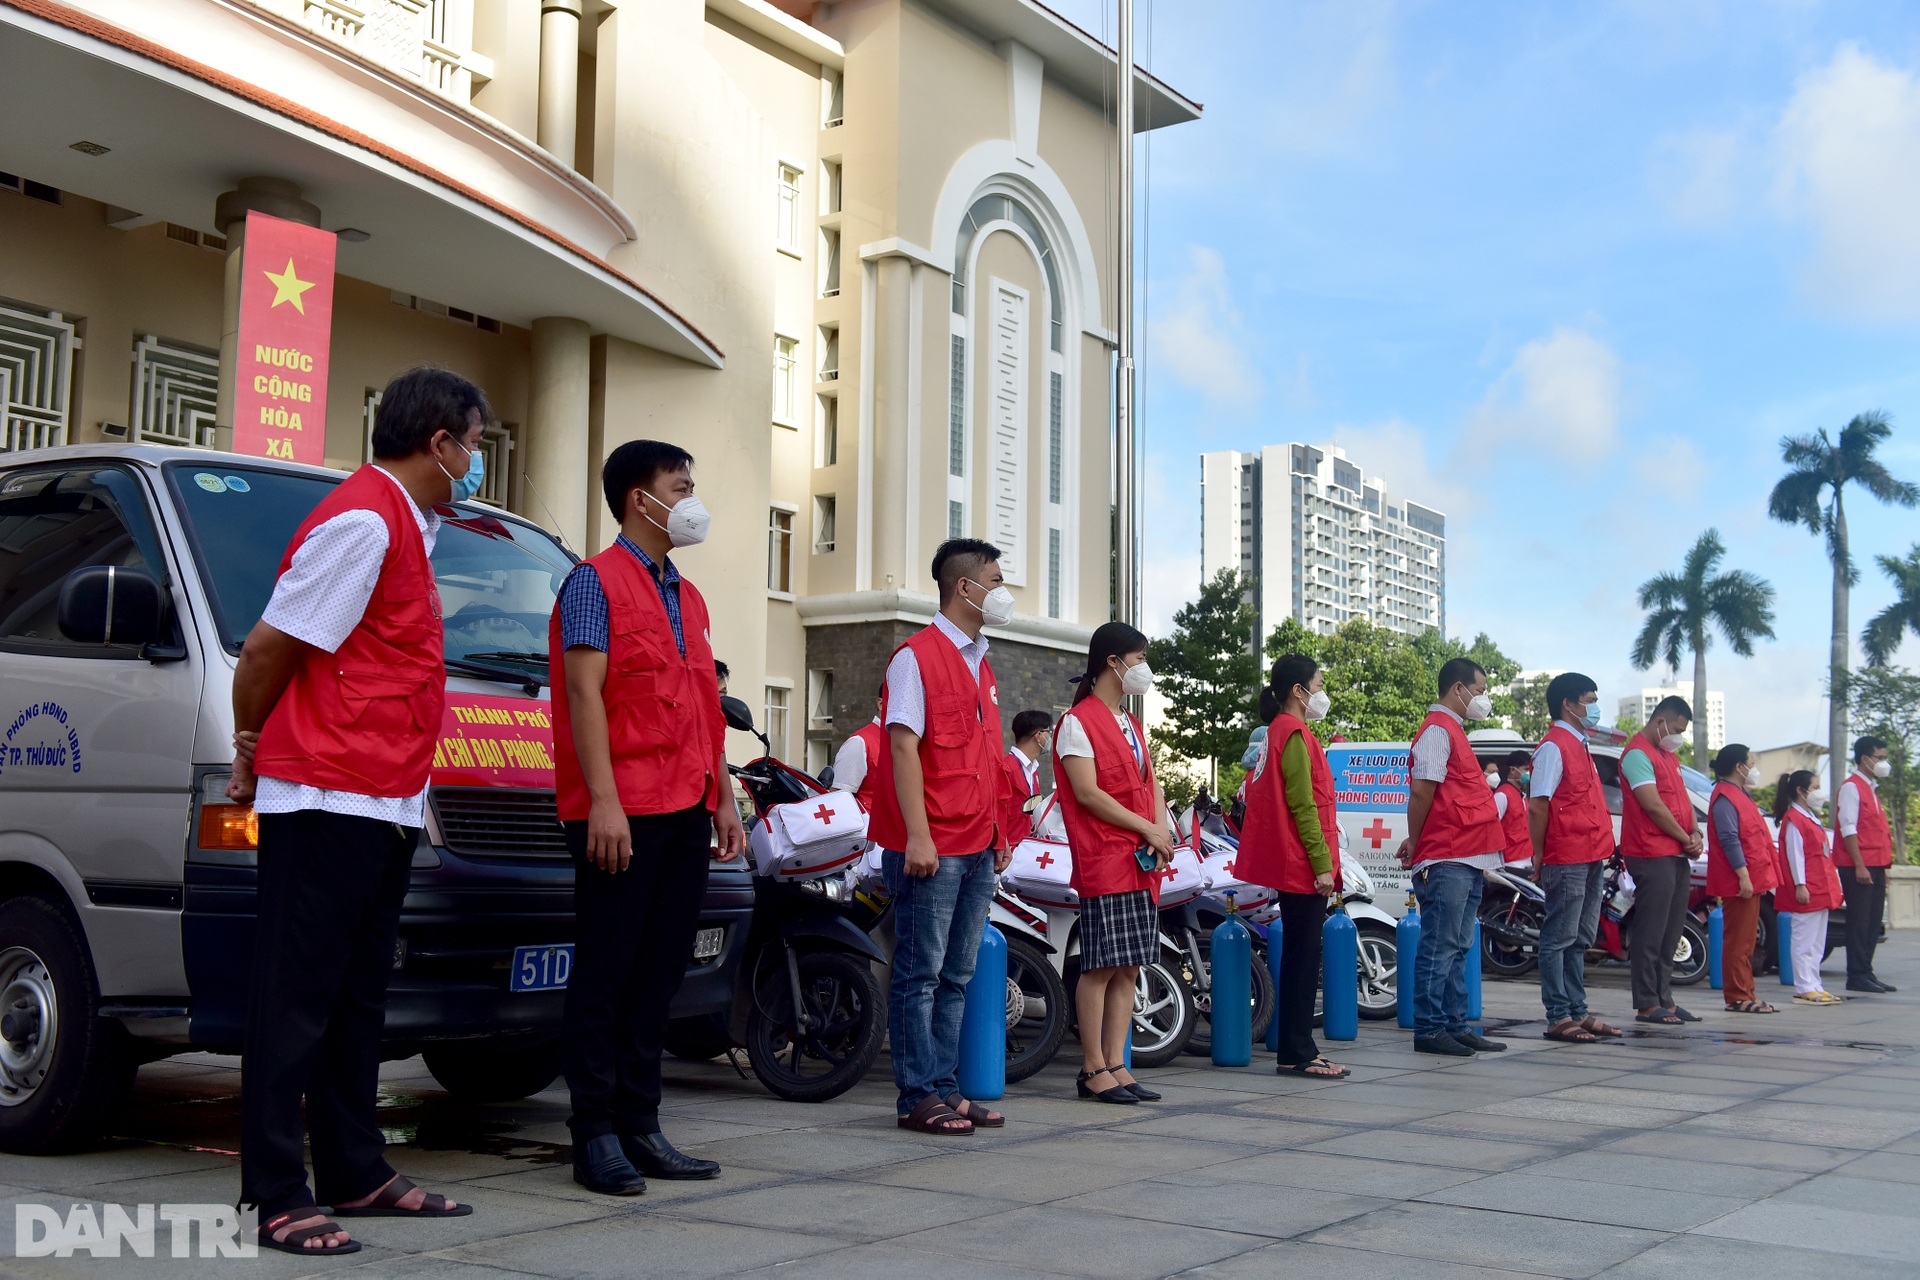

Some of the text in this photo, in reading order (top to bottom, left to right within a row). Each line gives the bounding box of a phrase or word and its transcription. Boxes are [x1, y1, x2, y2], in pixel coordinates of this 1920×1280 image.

[255, 344, 313, 373] NƯỚC
[254, 375, 312, 403] CỘNG
[260, 405, 303, 431] HÒA
[266, 437, 294, 460] XÃ
[450, 704, 550, 728] THÀNH PHỐ
[6, 703, 39, 741] PHÒNG
[41, 701, 68, 724] HĐND
[67, 728, 81, 773] UBND
[9, 747, 23, 766] TP.
[26, 741, 45, 766] THỦ
[46, 739, 66, 766] ĐỨC
[443, 728, 476, 768] CHỈ
[469, 738, 506, 775] ĐẠO
[1349, 755, 1363, 767] XE
[1366, 755, 1388, 767] LƯU
[1379, 770, 1400, 785] VẮC
[521, 949, 570, 986] 51D
